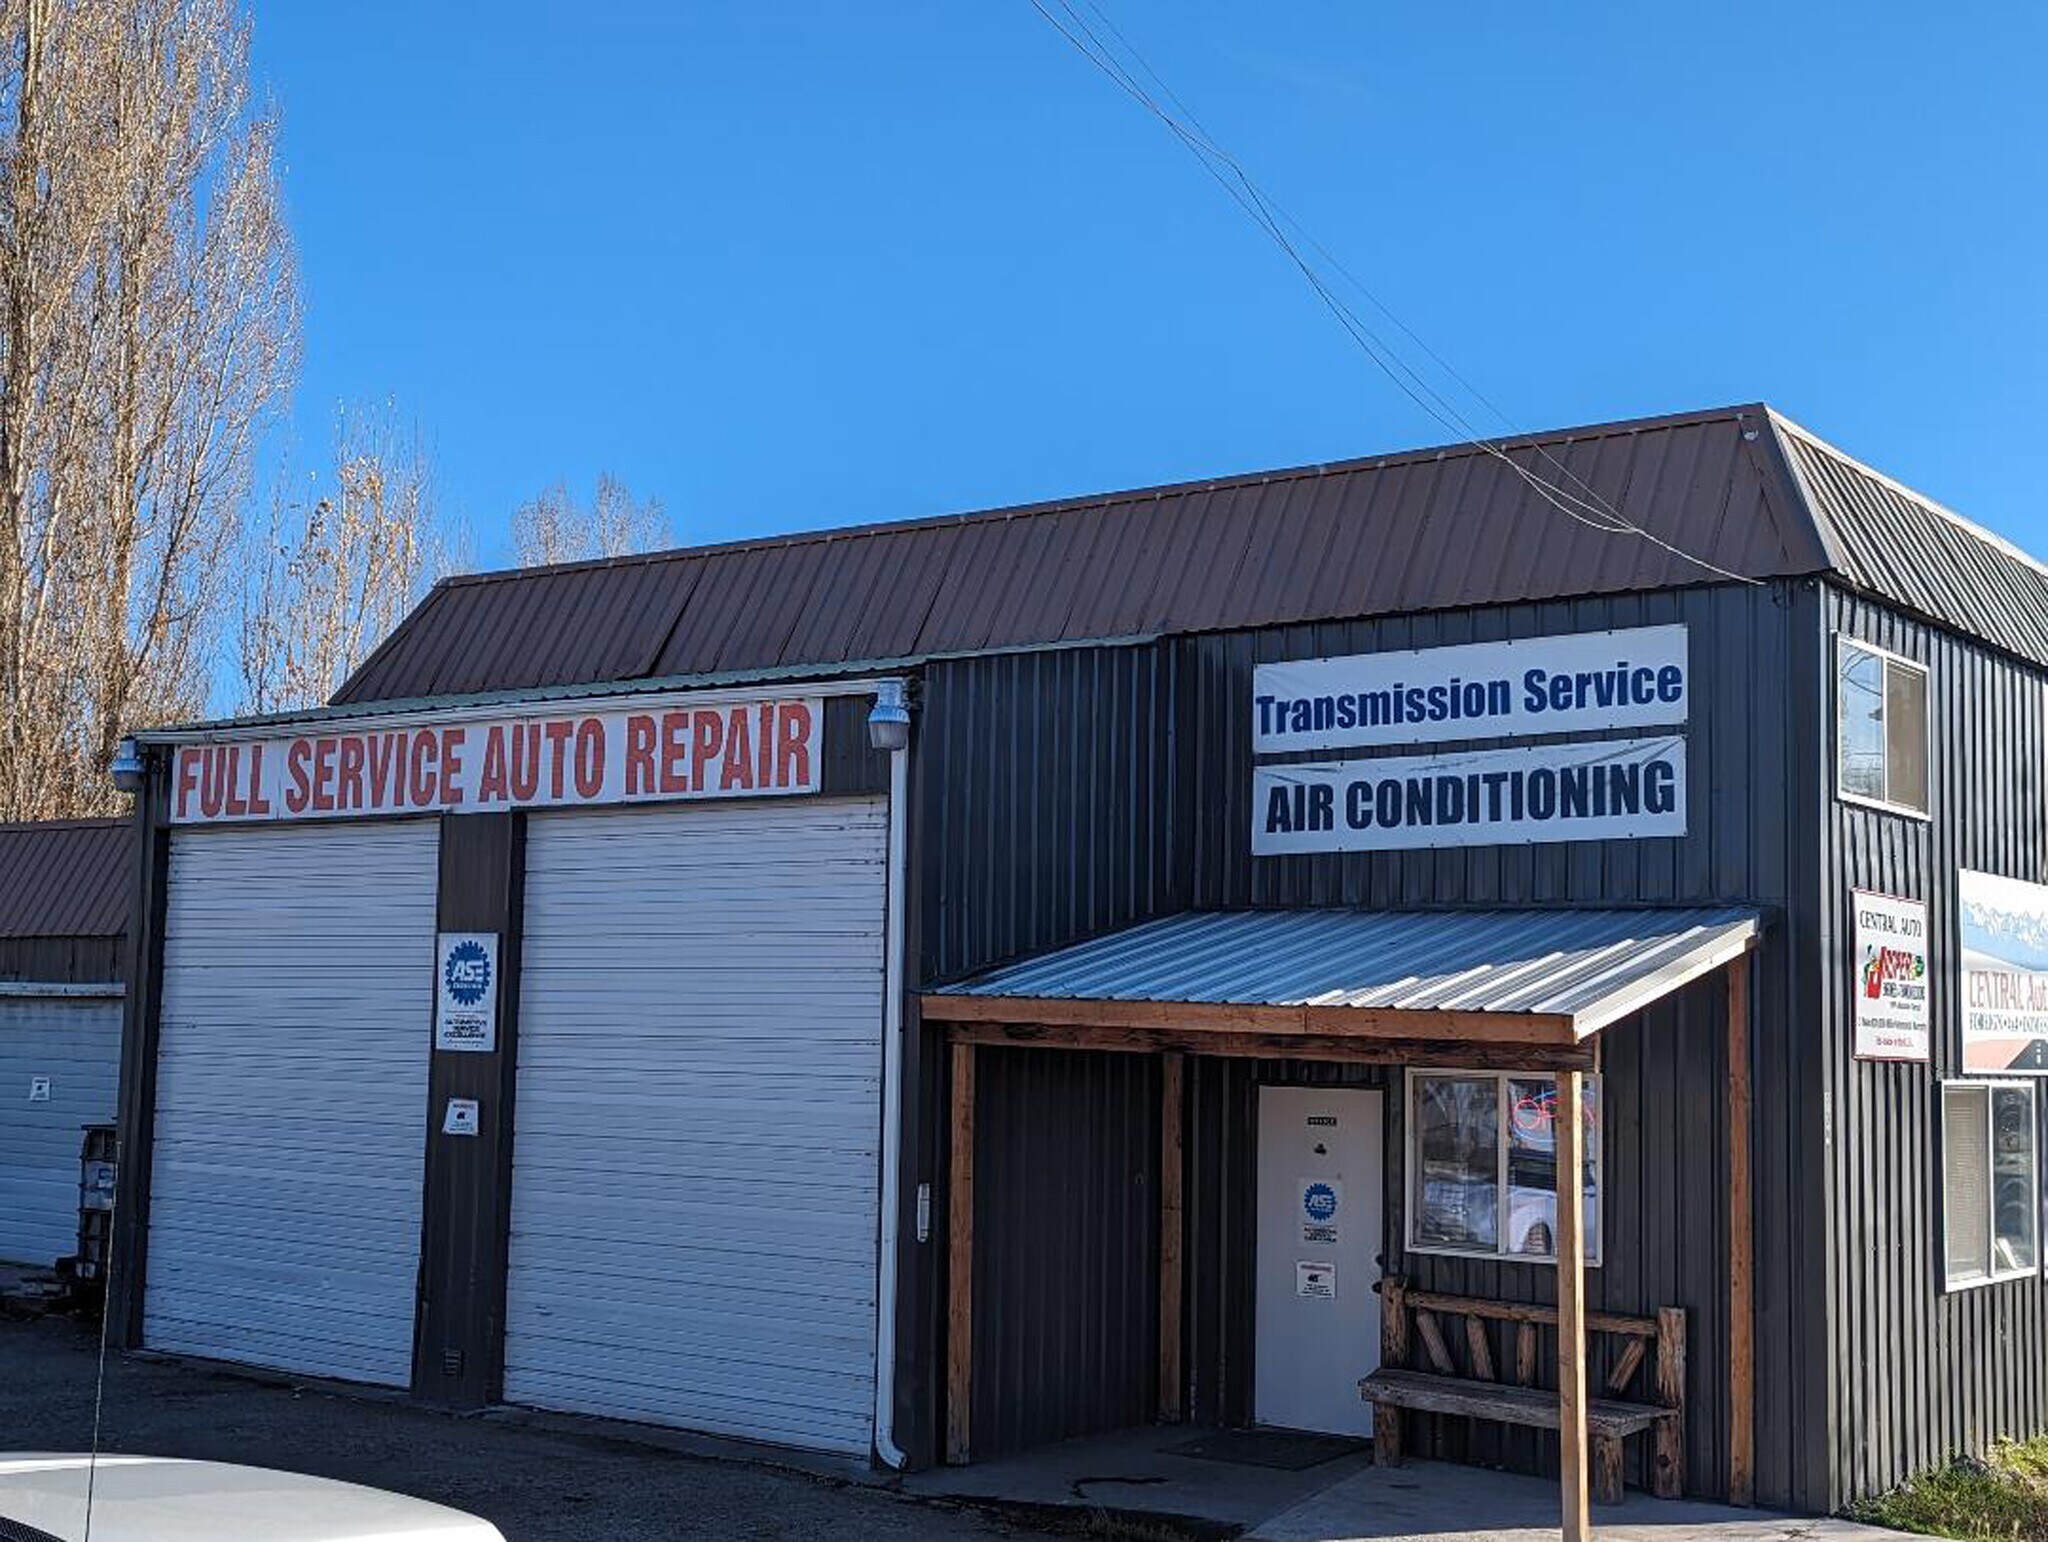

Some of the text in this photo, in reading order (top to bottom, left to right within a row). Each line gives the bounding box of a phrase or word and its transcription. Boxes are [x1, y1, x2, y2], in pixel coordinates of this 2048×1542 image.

[1255, 661, 1683, 736] Transmission Service
[175, 702, 812, 819] FULL SERVICE AUTO REPAIR
[1265, 759, 1676, 834] AIR CONDITIONING
[1860, 909, 1922, 938] CENTRAL AUTO
[450, 959, 484, 982] ASE
[1969, 970, 2024, 1010] CENTRAL
